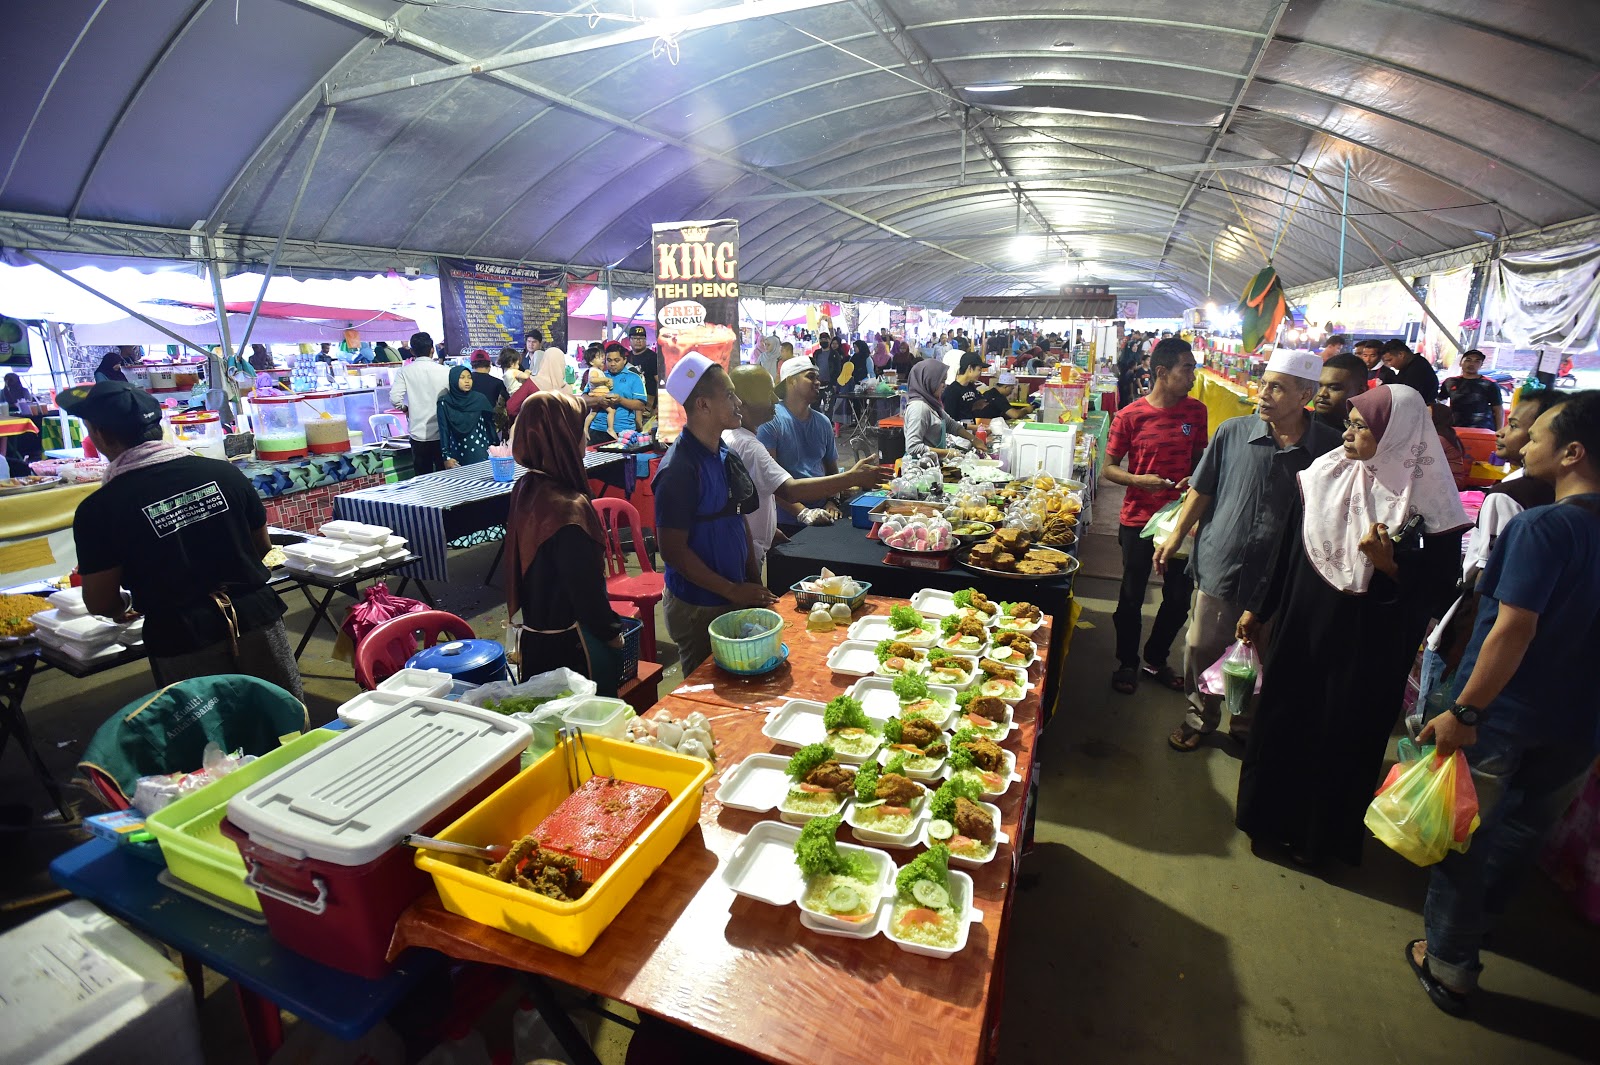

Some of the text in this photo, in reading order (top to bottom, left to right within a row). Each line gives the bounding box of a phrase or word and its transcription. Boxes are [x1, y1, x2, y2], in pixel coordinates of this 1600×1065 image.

[475, 263, 509, 275] SELAMAT
[511, 268, 540, 279] DATANG
[657, 242, 737, 280] KING
[655, 283, 738, 298] TEH PENG
[663, 305, 703, 317] FREE
[664, 316, 702, 325] CINCAU
[155, 503, 198, 525] MECHANICAL
[205, 495, 222, 504] MOC
[158, 507, 206, 529] TURNAROUND
[207, 500, 224, 510] 2019
[166, 695, 220, 739] Kualiti Antarabangsa
